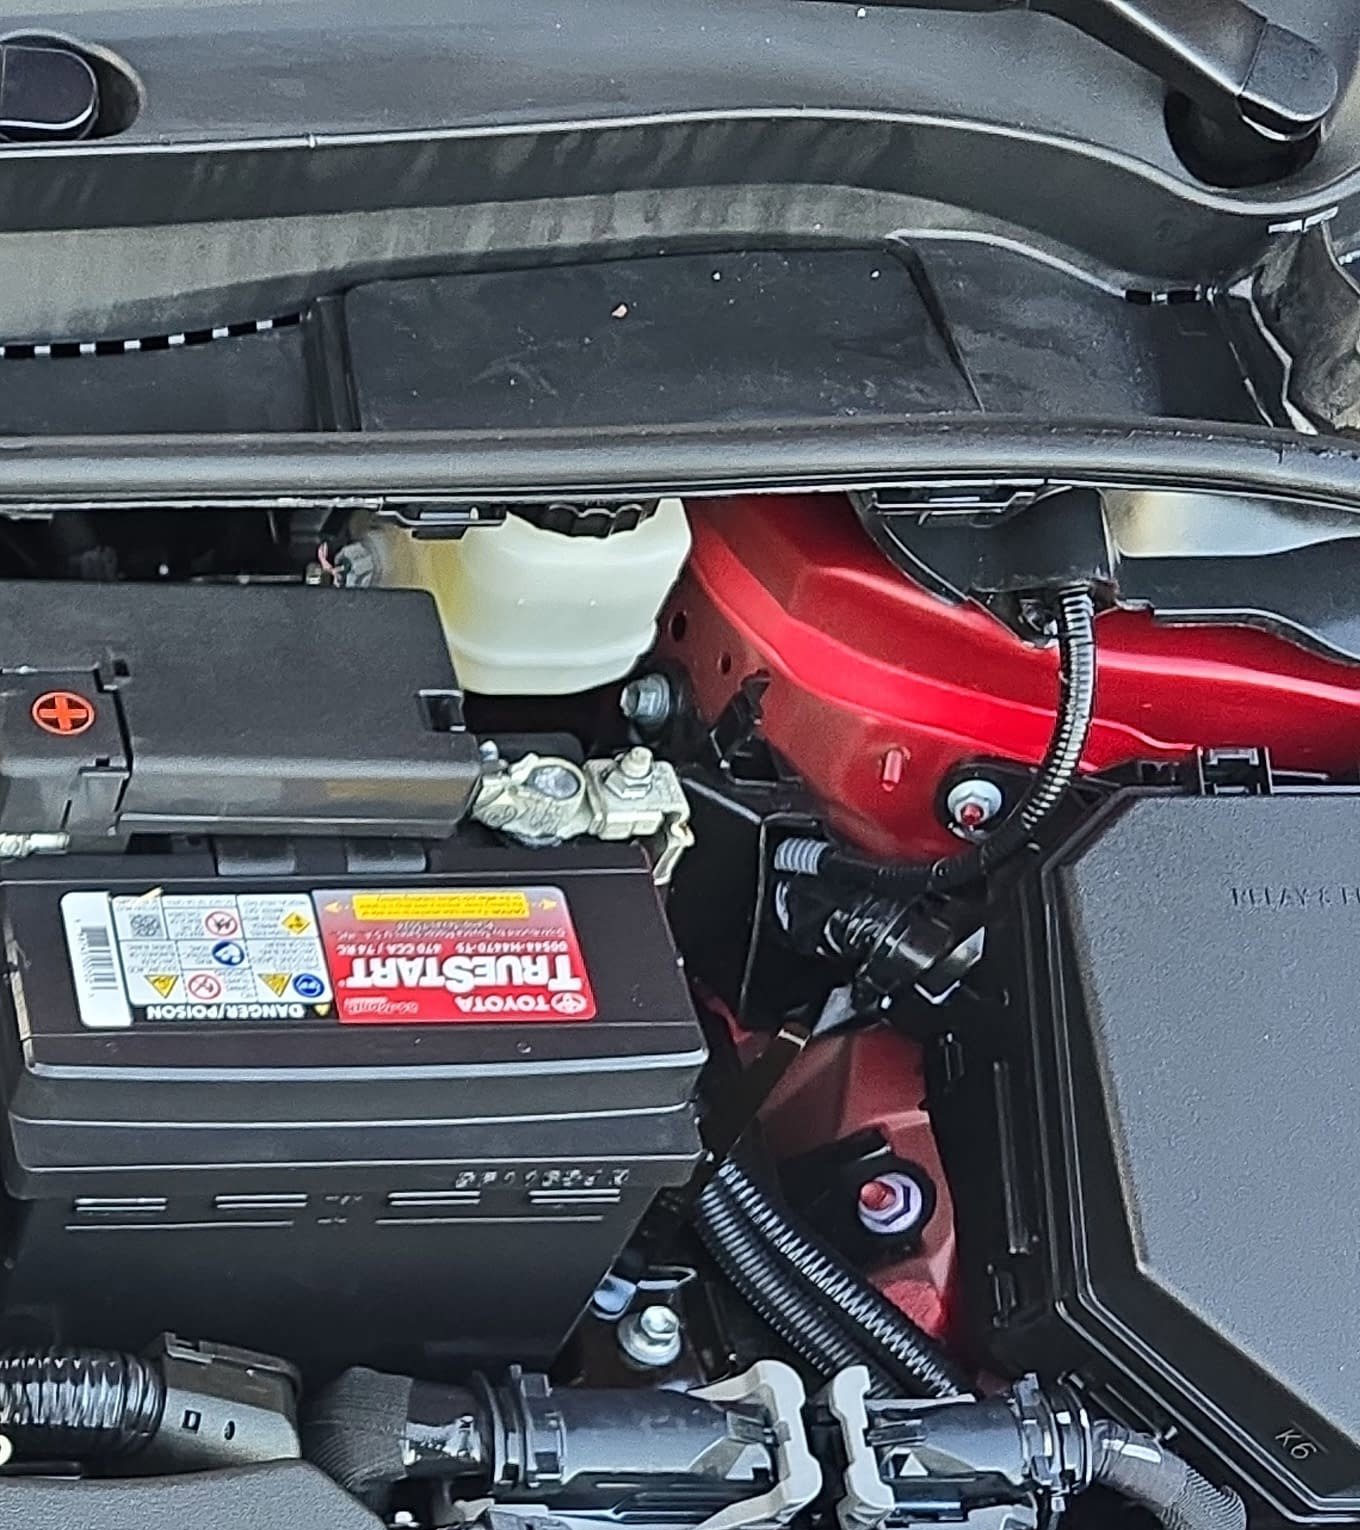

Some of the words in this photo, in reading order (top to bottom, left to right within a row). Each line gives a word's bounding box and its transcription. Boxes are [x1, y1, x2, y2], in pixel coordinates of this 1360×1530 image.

[146, 1003, 305, 1020] DANGER/POISON
[454, 995, 551, 1013] TOYOTA
[1274, 1428, 1317, 1460] K6
